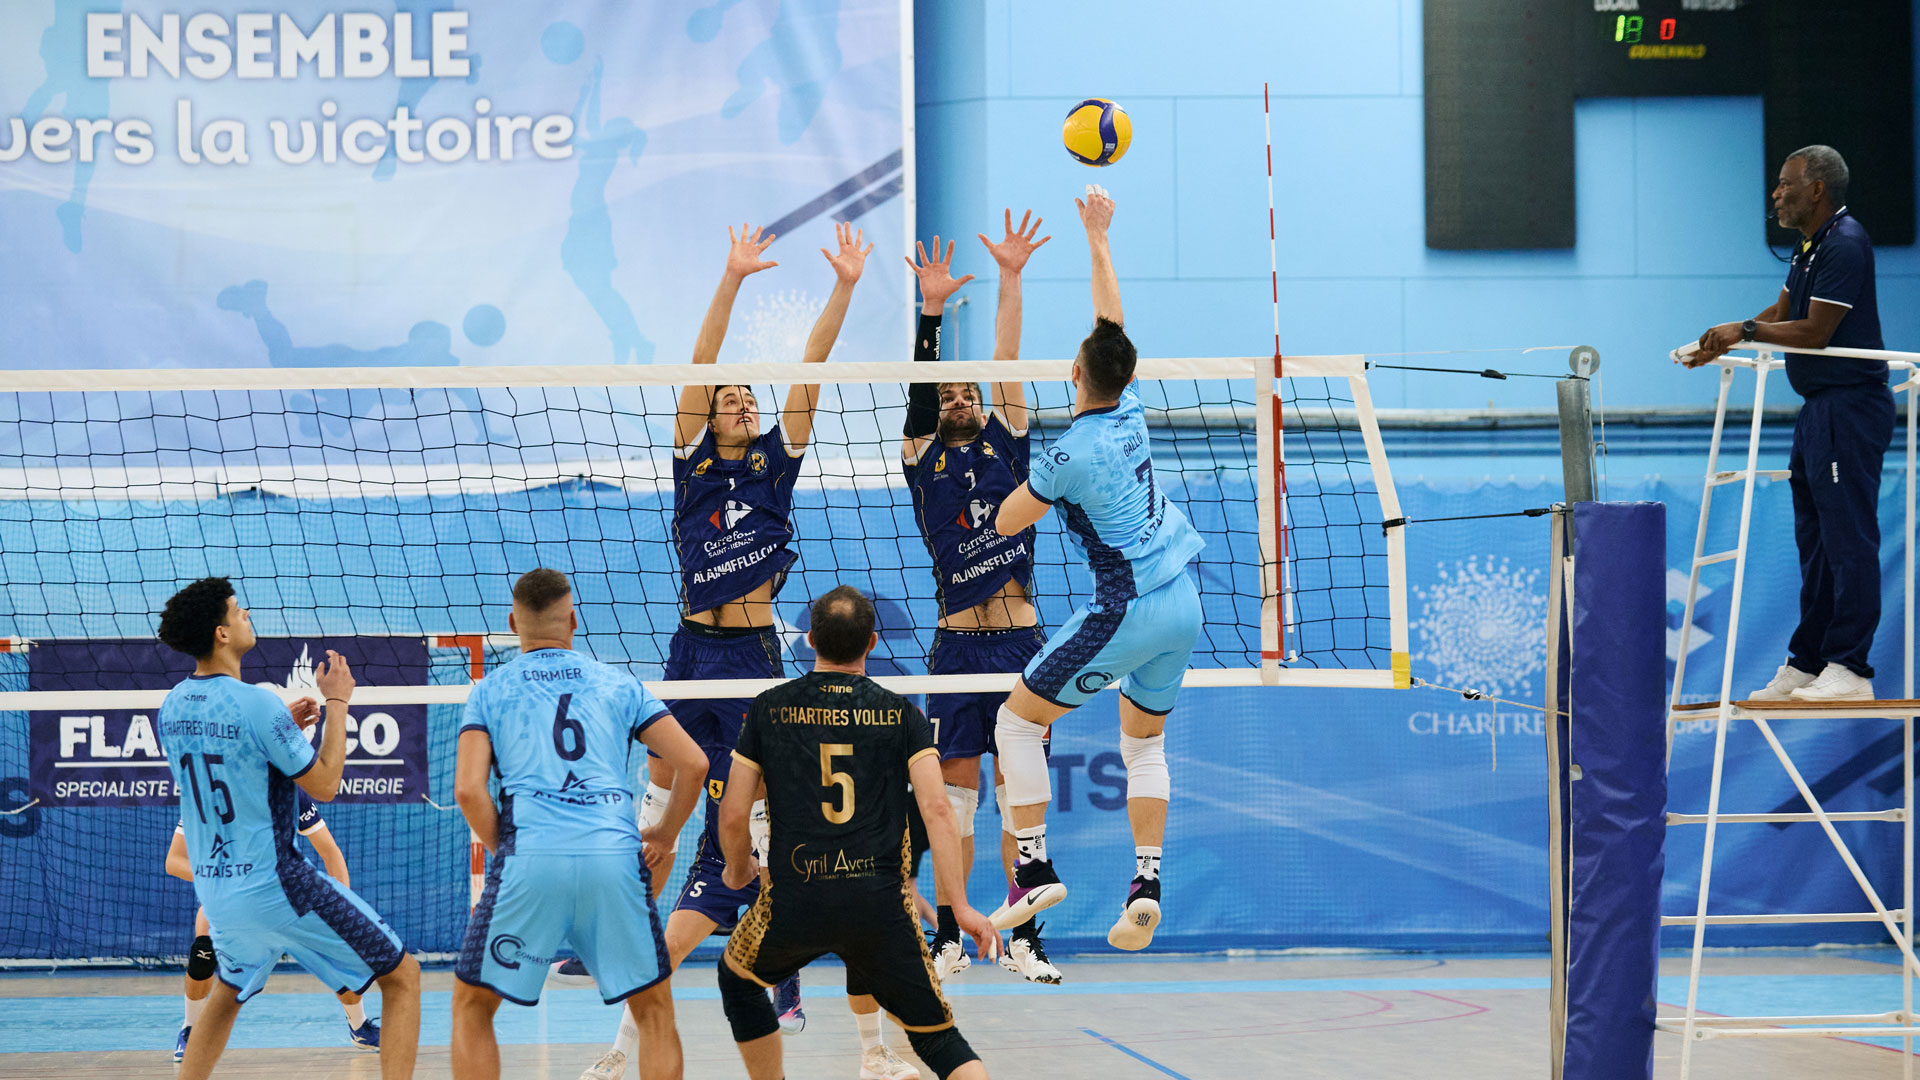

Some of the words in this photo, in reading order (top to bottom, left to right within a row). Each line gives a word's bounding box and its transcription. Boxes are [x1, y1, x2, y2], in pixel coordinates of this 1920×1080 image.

[86, 11, 471, 79] ENSEMBLE
[177, 99, 249, 164] la
[270, 98, 575, 164] victoire
[933, 325, 941, 360] Kempa
[1123, 431, 1143, 457] GALLO
[1135, 456, 1155, 519] 7
[707, 546, 728, 559] SAINT
[958, 528, 996, 554] Carrefo
[522, 667, 583, 682] CORMIER
[827, 685, 853, 693] nine
[552, 692, 587, 762] 6
[853, 708, 902, 726] VOLLEY
[1408, 711, 1546, 736] CHARTRE
[204, 722, 240, 740] VOLLEY
[55, 780, 169, 798] SPECIALISTE
[336, 778, 405, 795] NERGIE
[180, 752, 236, 825] 15
[819, 743, 856, 825] 5
[600, 793, 622, 805] TP
[235, 863, 253, 877] TP
[791, 843, 828, 883] Cyril
